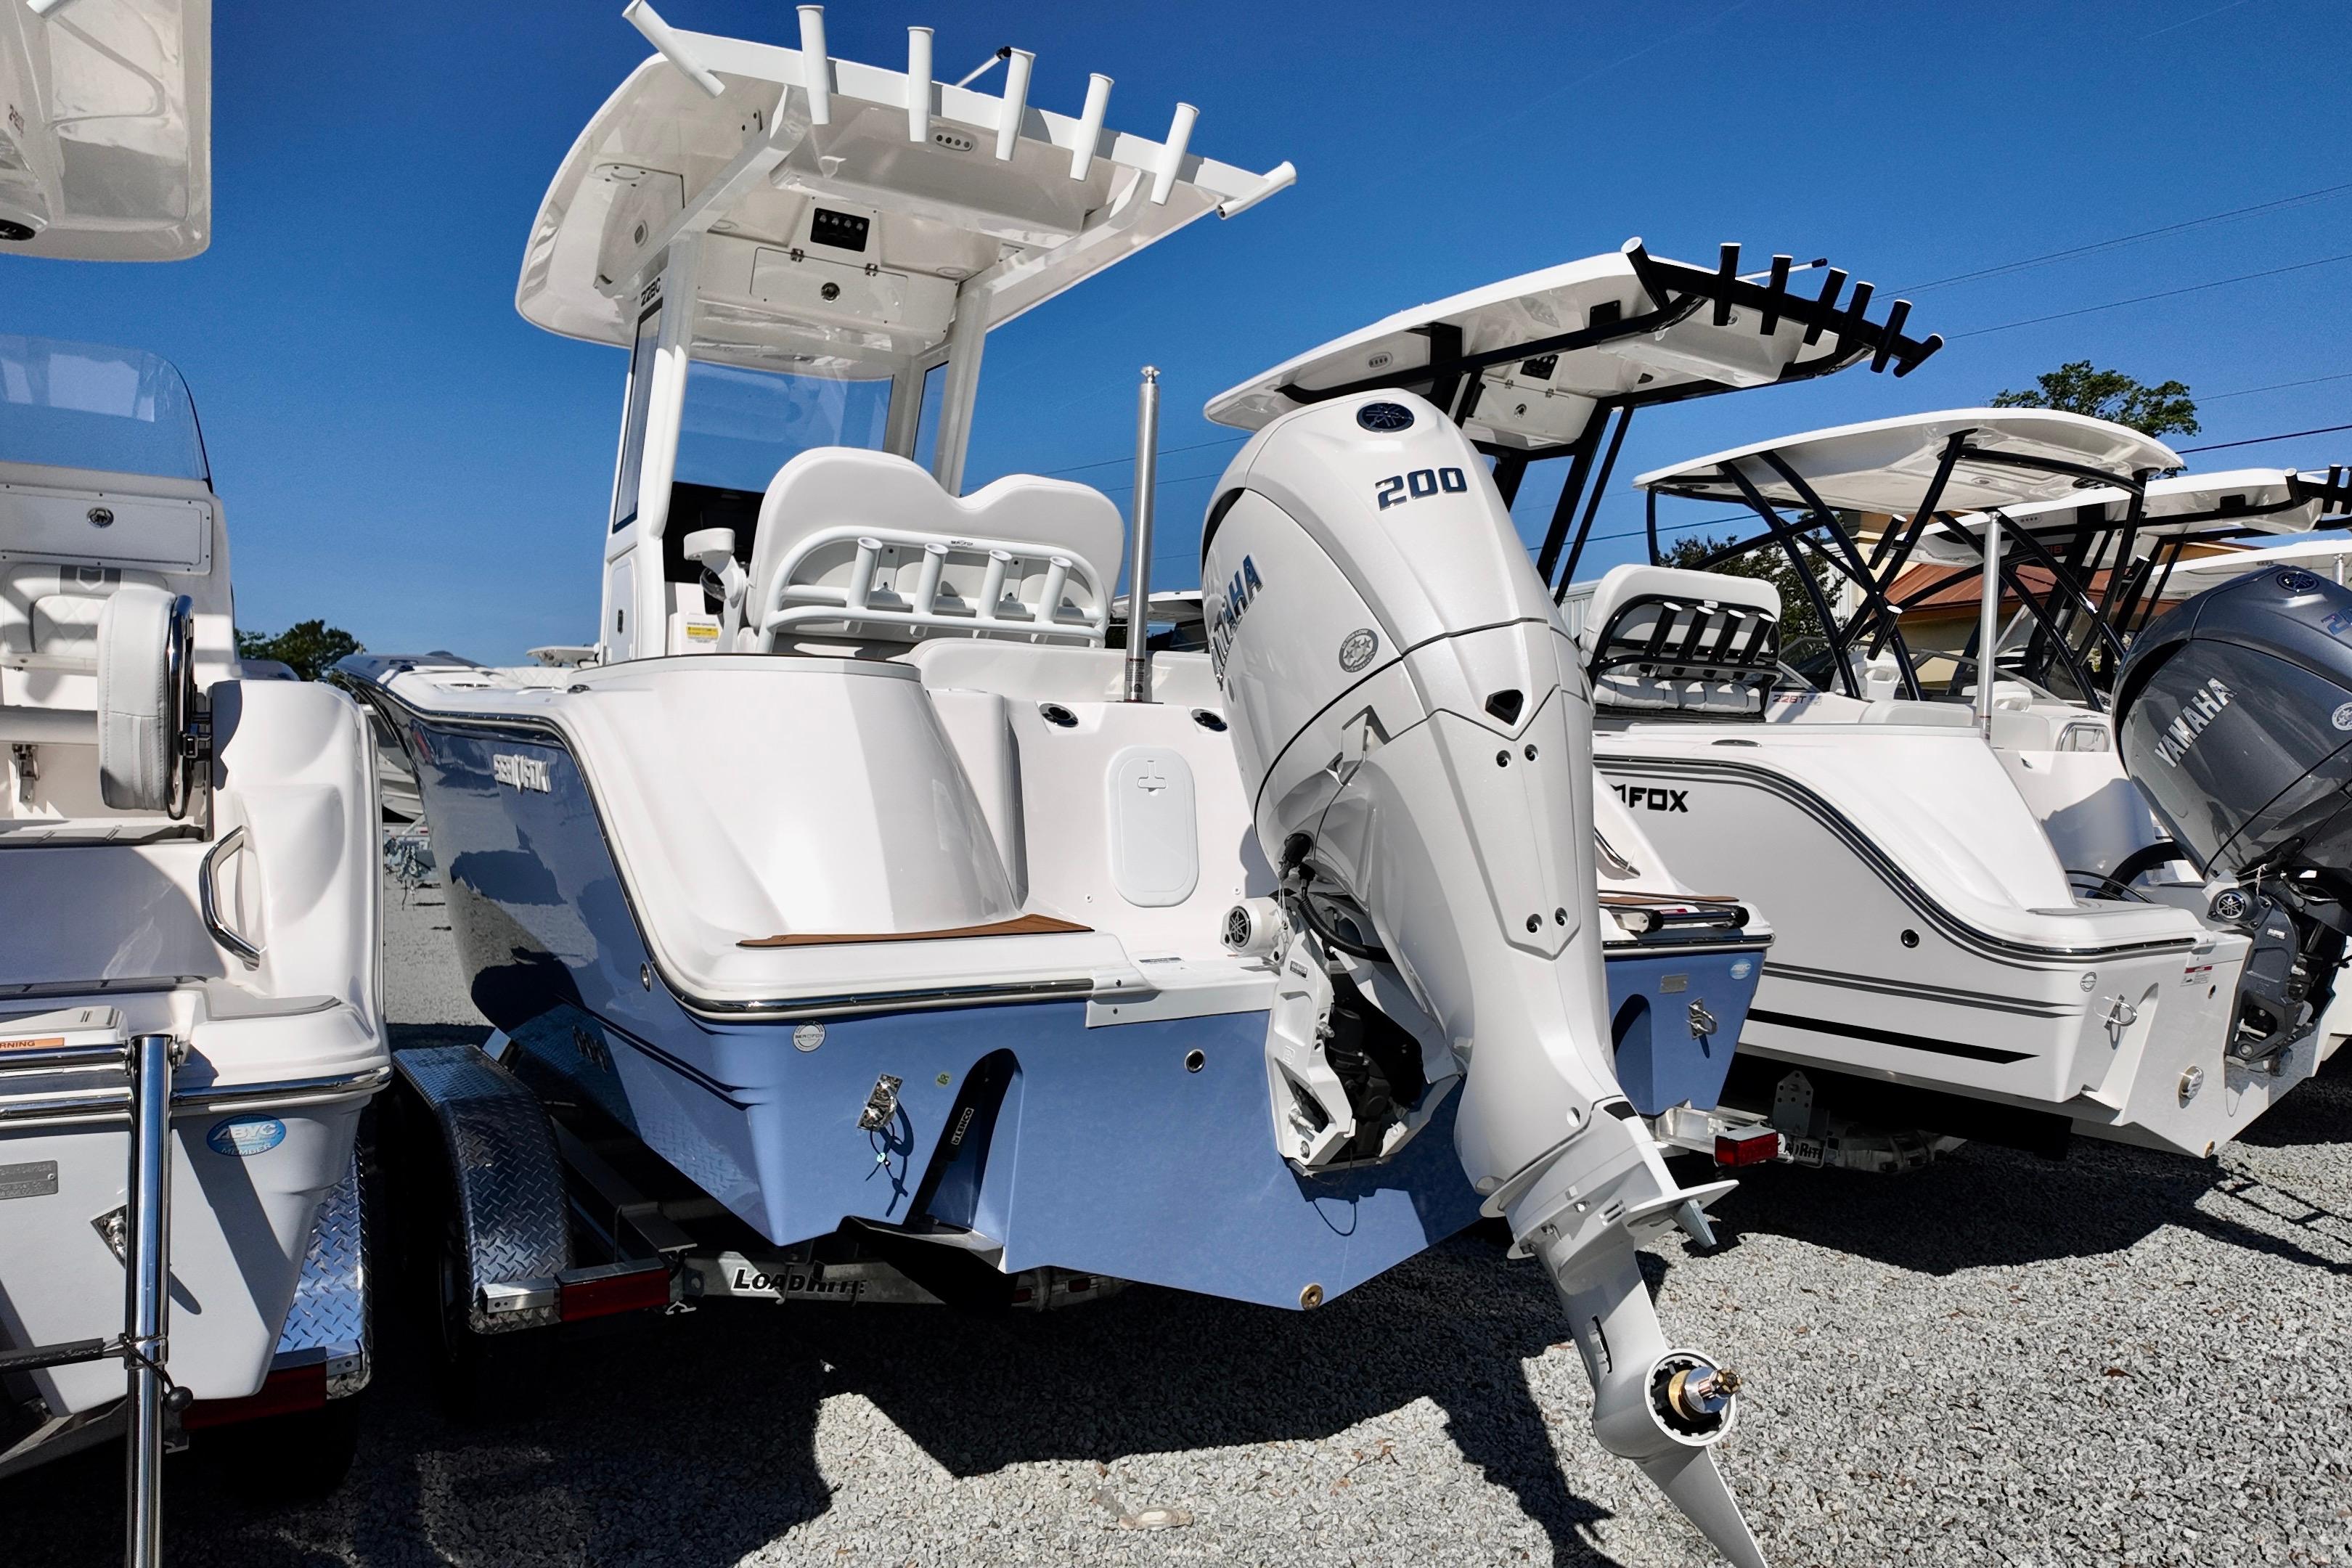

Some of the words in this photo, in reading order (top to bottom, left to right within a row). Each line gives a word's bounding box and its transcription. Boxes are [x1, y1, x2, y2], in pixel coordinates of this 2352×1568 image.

[1375, 467, 1468, 512] 200
[2154, 677, 2238, 768] YAMAHA
[1628, 786, 1689, 813] FOX
[212, 1122, 277, 1141] ABYC
[956, 1108, 973, 1138] LENCO
[221, 1145, 271, 1156] MEMBER
